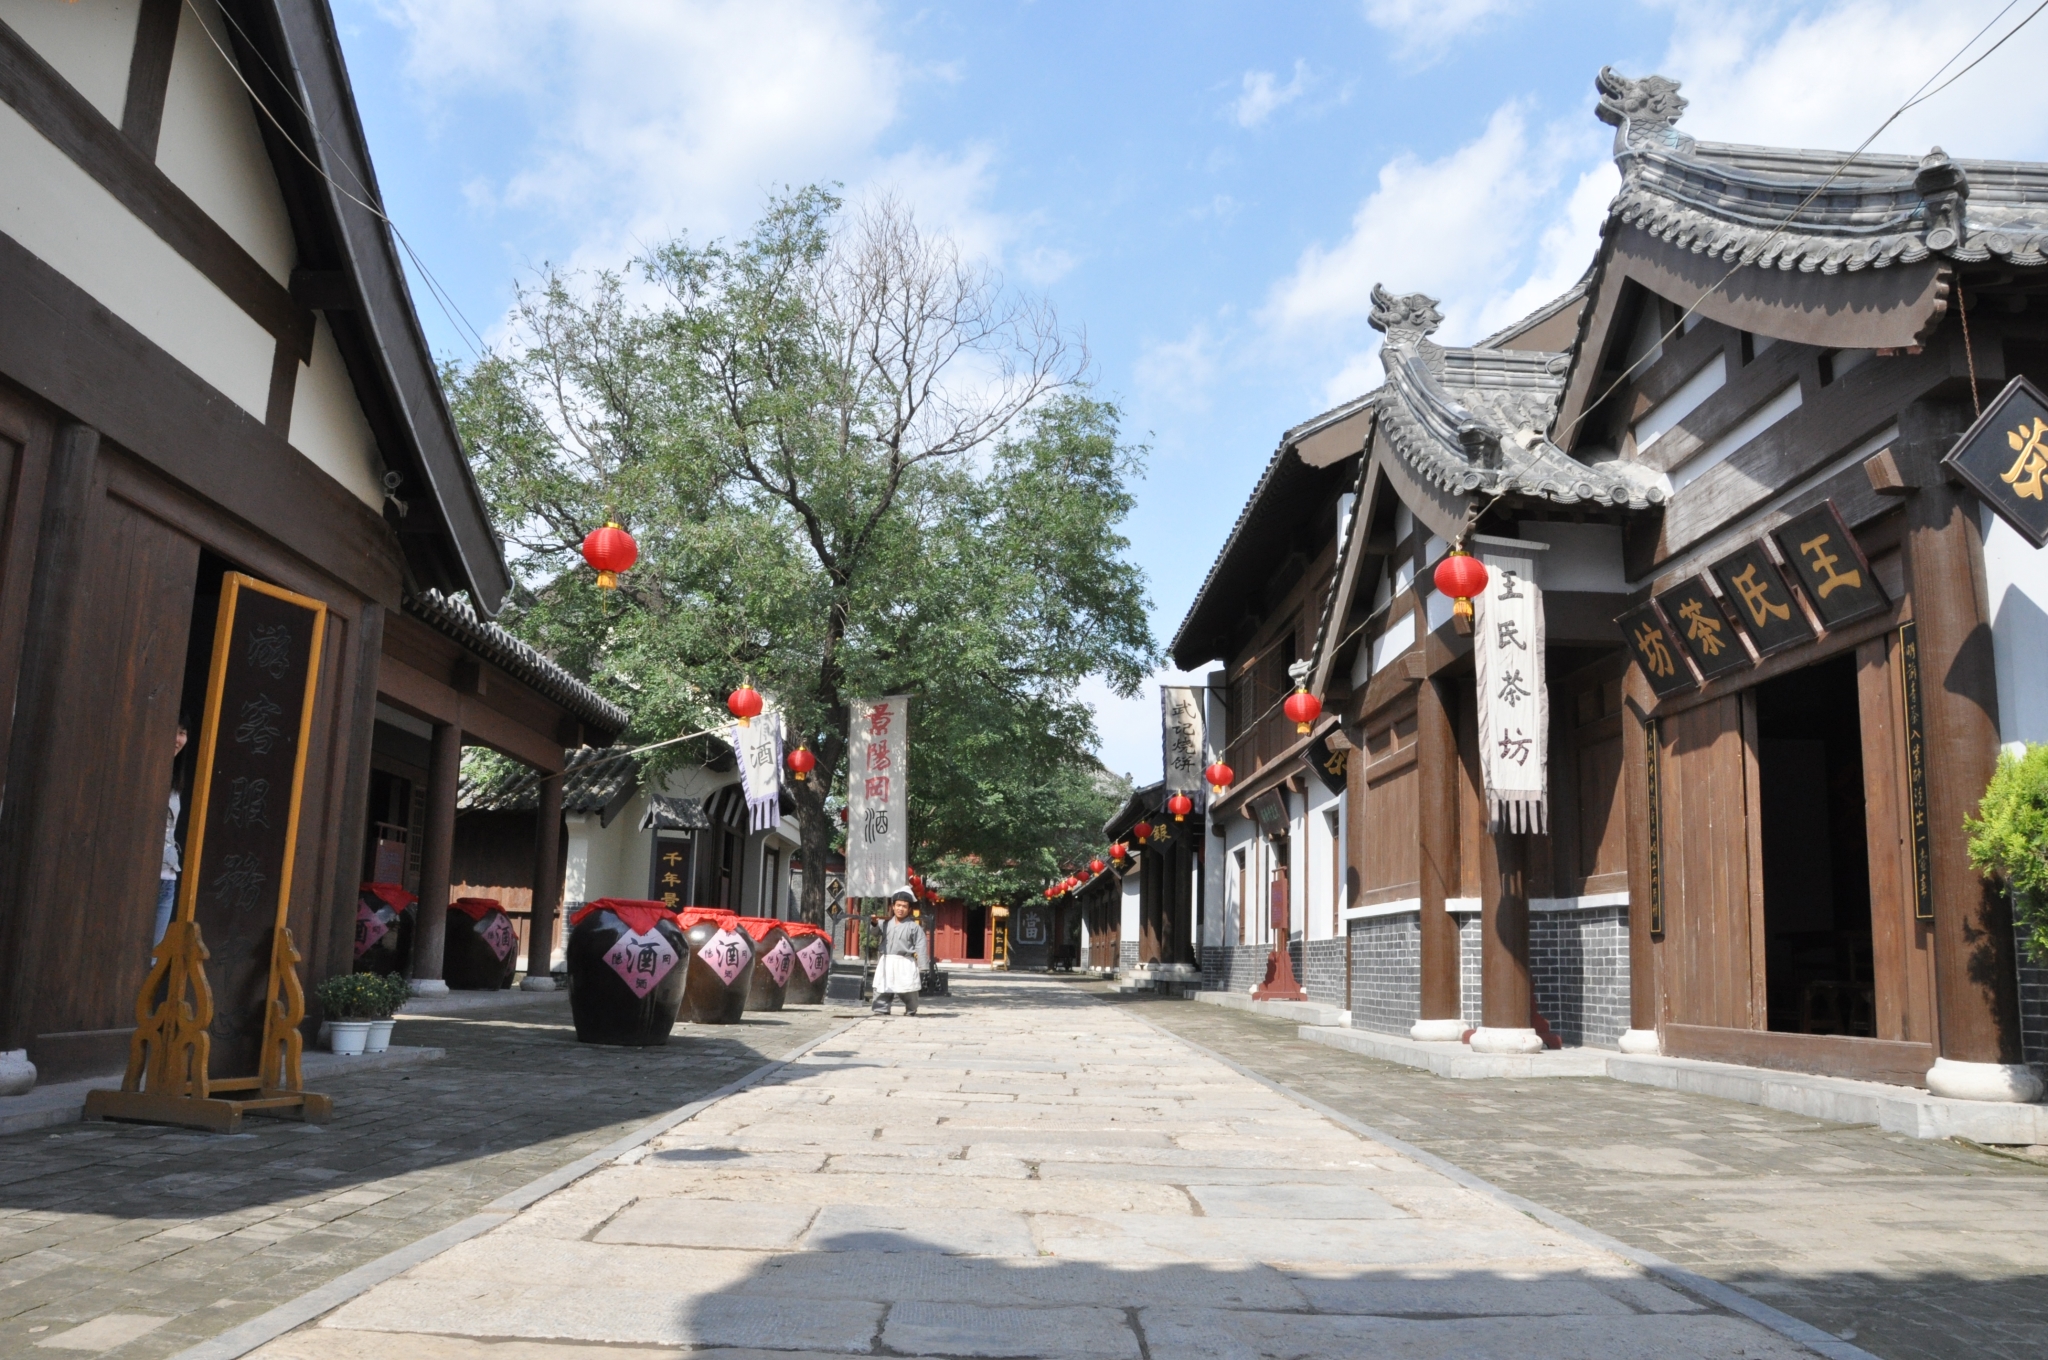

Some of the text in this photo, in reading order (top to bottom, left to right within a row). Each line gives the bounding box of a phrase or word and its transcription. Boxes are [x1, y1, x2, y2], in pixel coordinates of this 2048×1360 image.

[1633, 533, 1862, 678] 王氏茶坊
[1497, 570, 1533, 767] 王氏茶坊
[1170, 699, 1196, 773] 武记烧饼
[750, 741, 774, 769] 酒
[660, 851, 683, 908] 千年景
[495, 924, 511, 948] 酒
[625, 937, 661, 978] 酒
[716, 939, 740, 969] 酒
[775, 949, 792, 975] 酒
[808, 949, 825, 971] 酒
